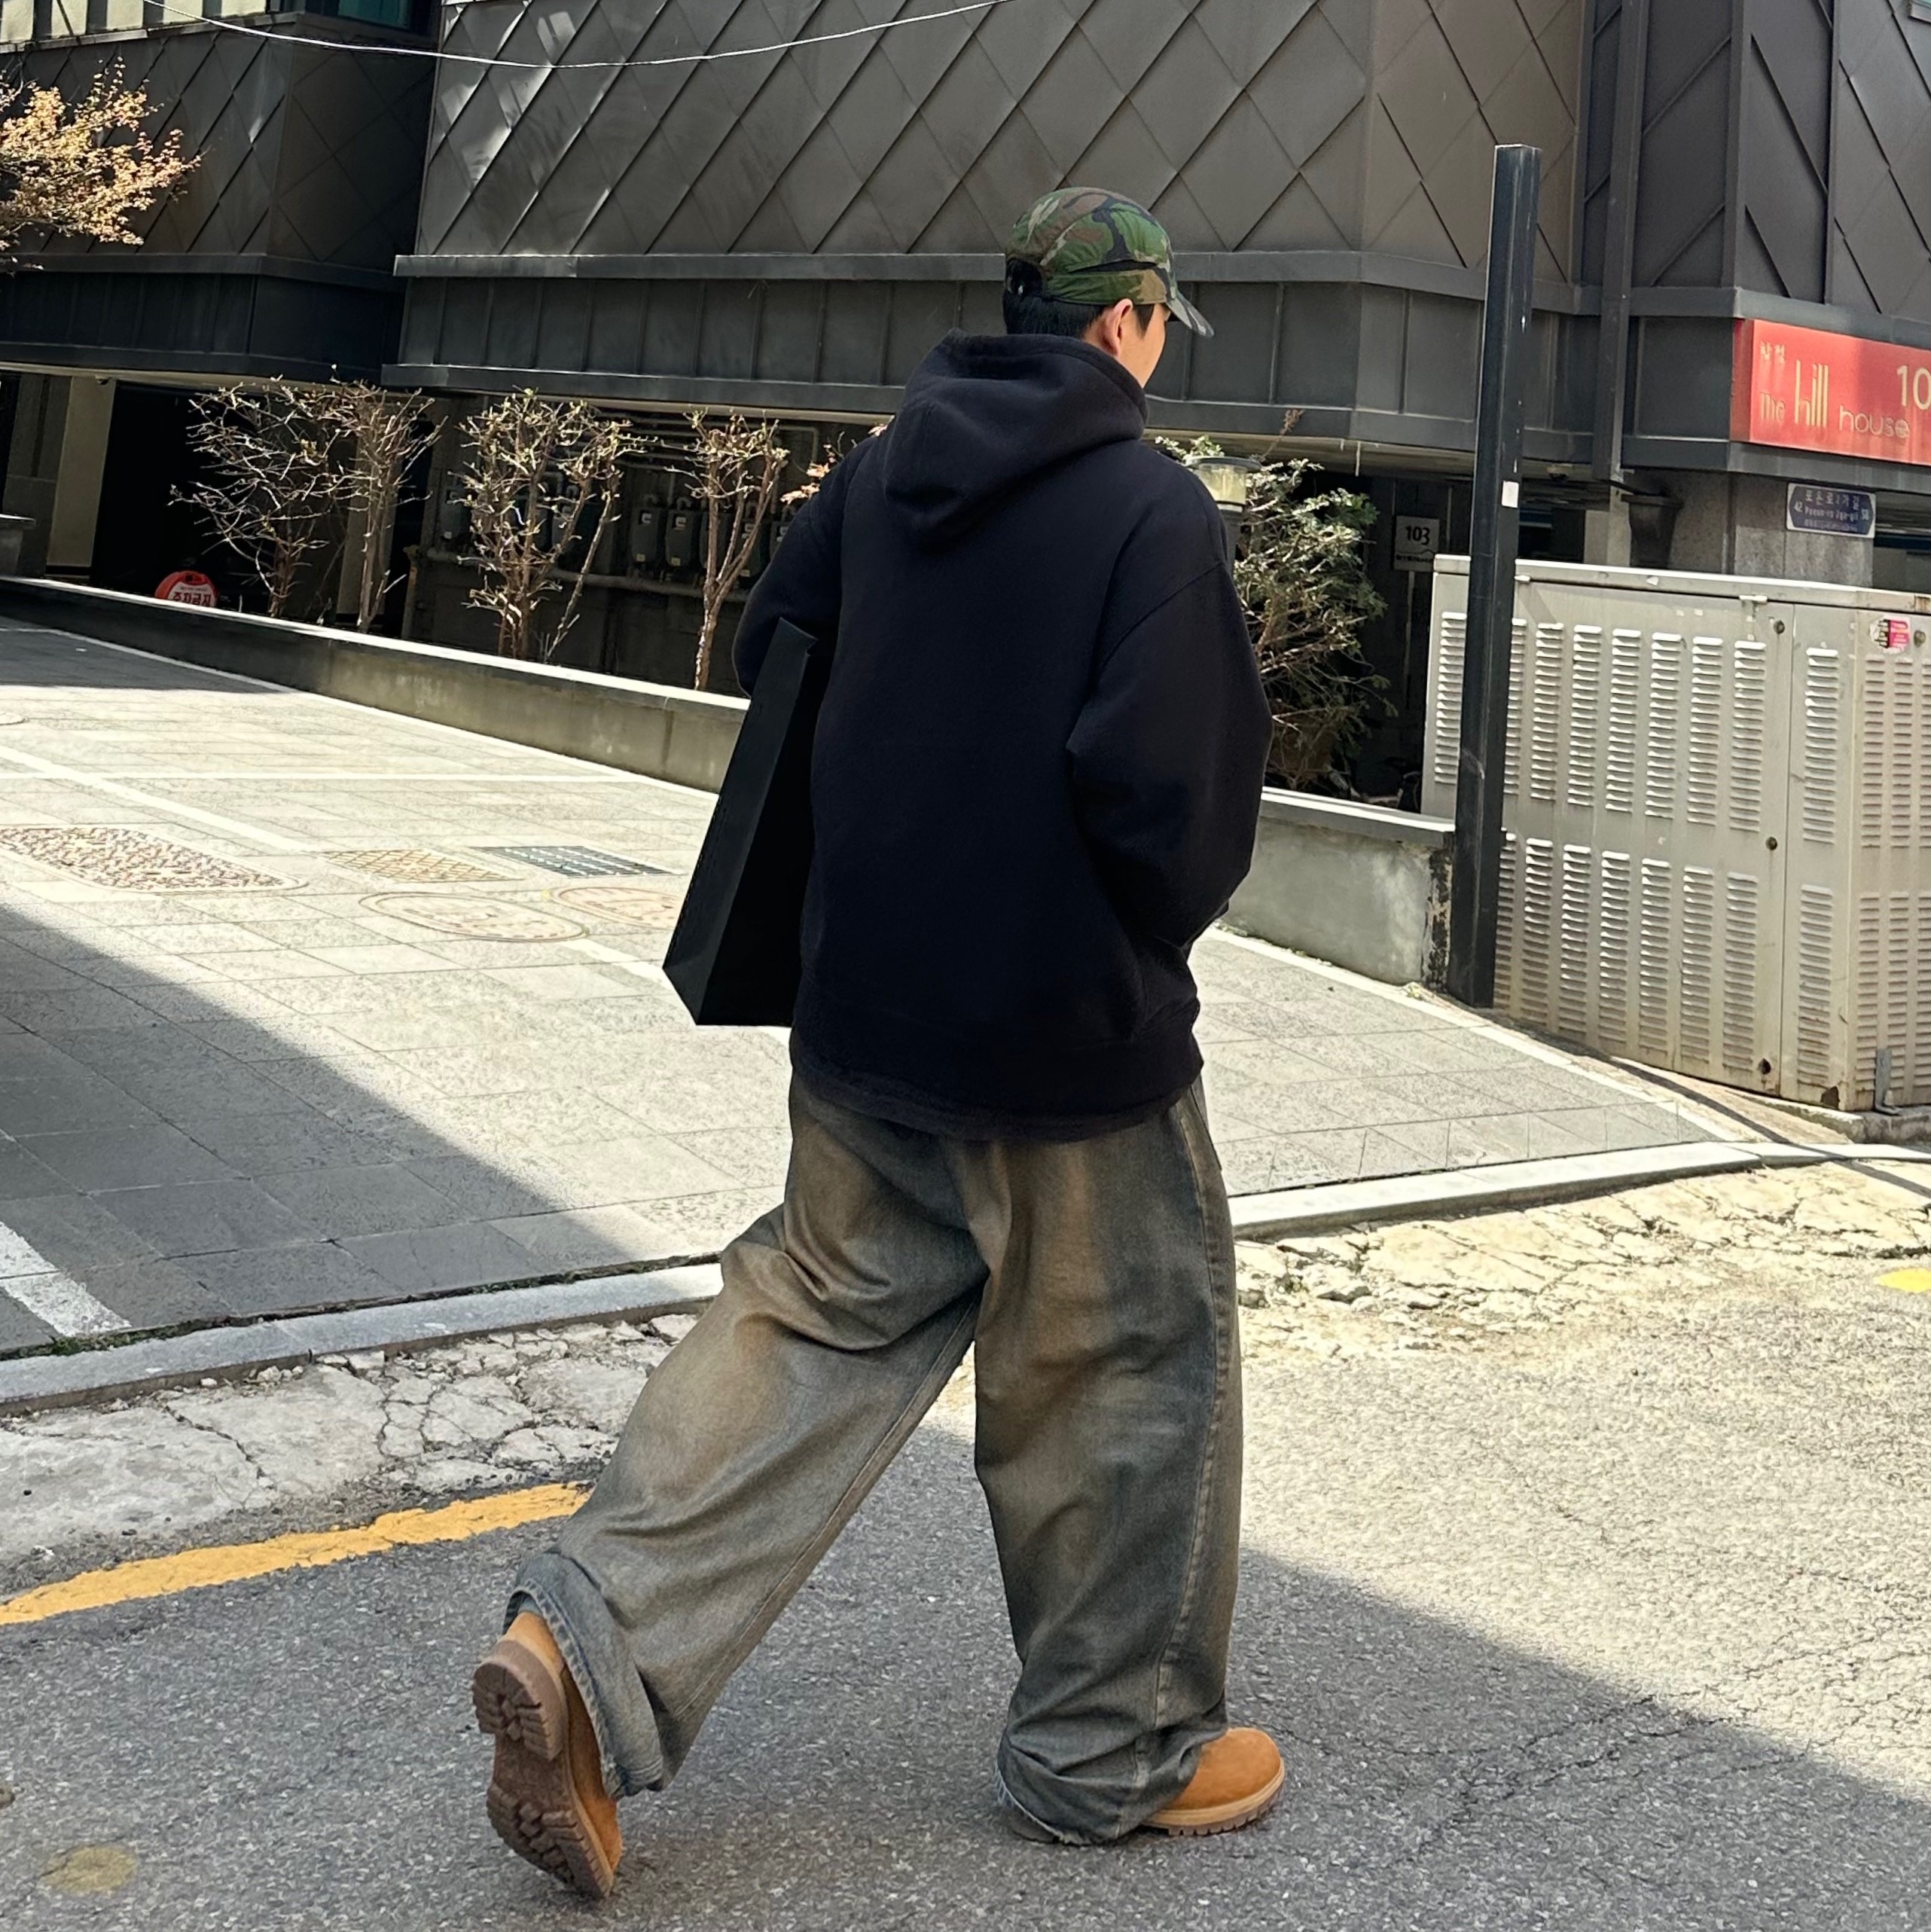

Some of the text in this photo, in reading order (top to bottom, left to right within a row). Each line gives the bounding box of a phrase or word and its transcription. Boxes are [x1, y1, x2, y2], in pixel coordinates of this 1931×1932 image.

[1760, 359, 1910, 438] The hill house
[1896, 365, 1931, 411] 10
[1405, 526, 1430, 545] 103
